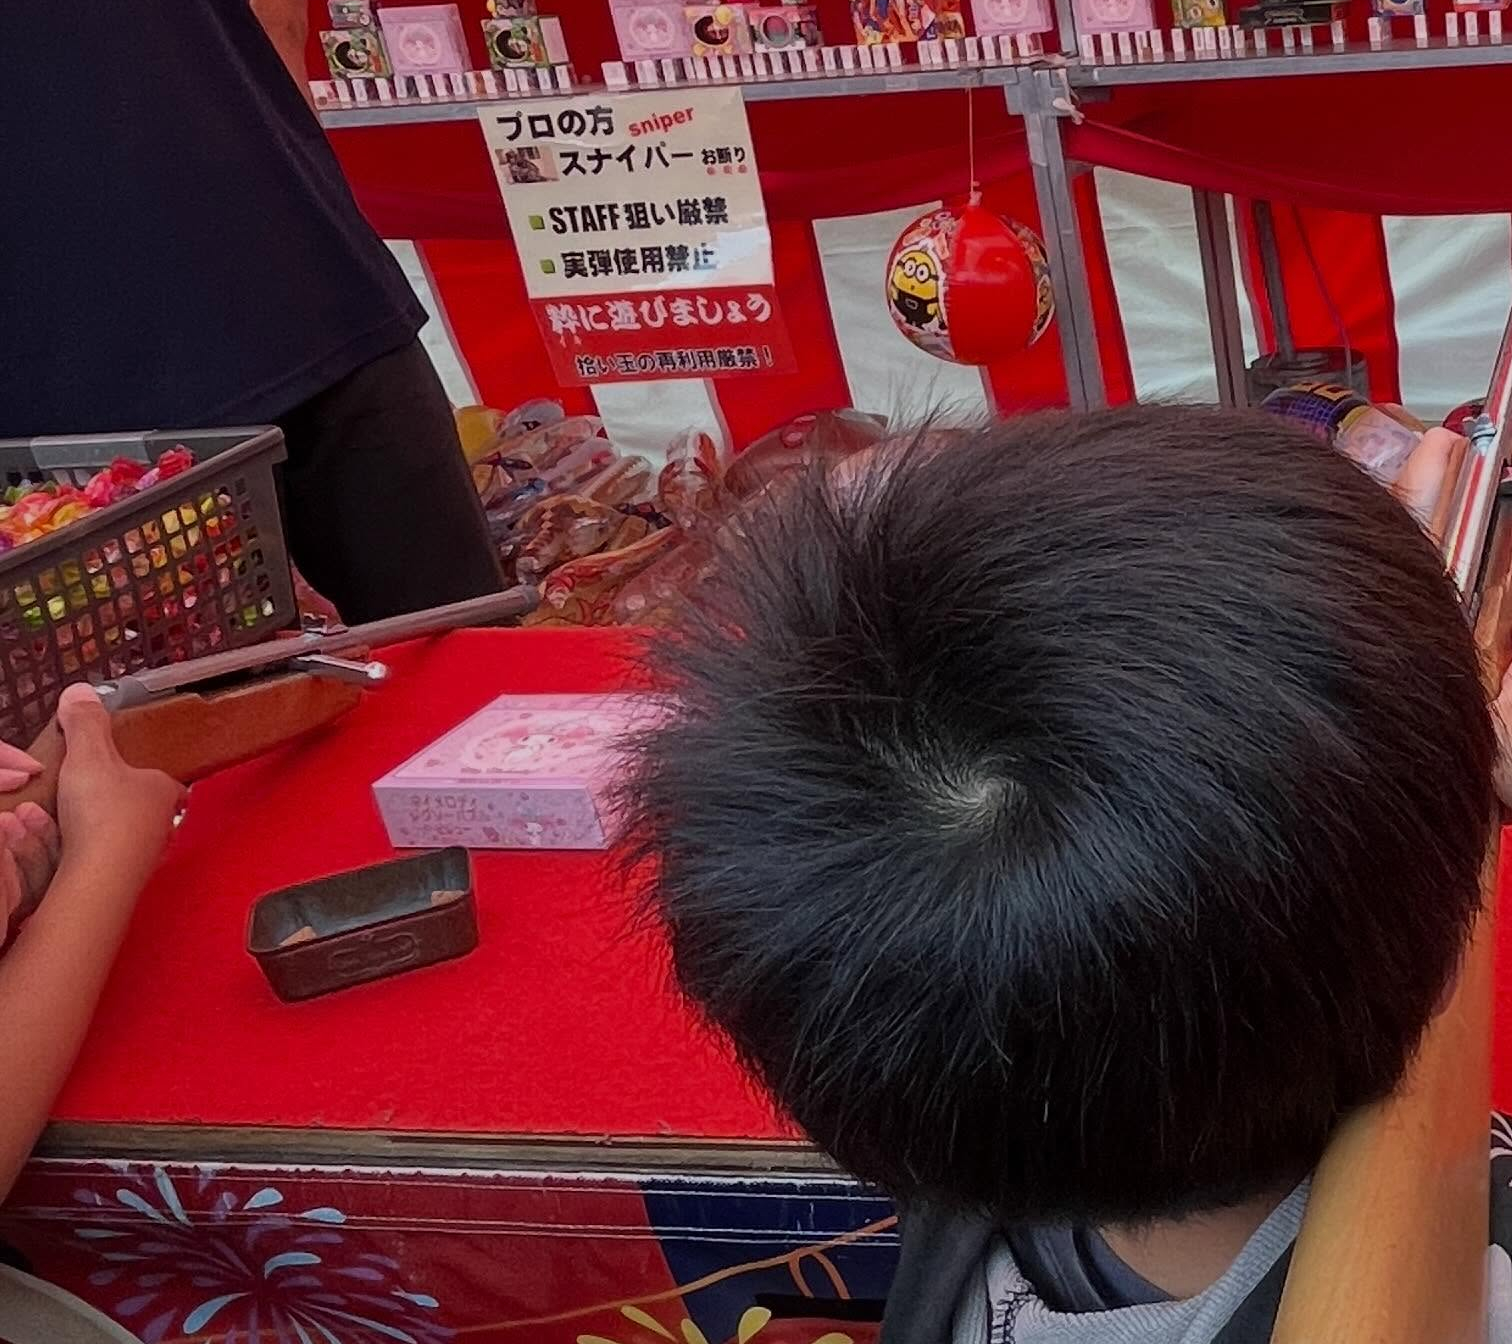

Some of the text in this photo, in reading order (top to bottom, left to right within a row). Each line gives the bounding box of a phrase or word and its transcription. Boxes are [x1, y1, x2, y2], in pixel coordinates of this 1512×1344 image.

[497, 105, 694, 140] プロの方 sniper
[559, 142, 693, 175] スナイパー
[549, 203, 620, 234] STAFF
[562, 243, 717, 278] 実弾使用禁止
